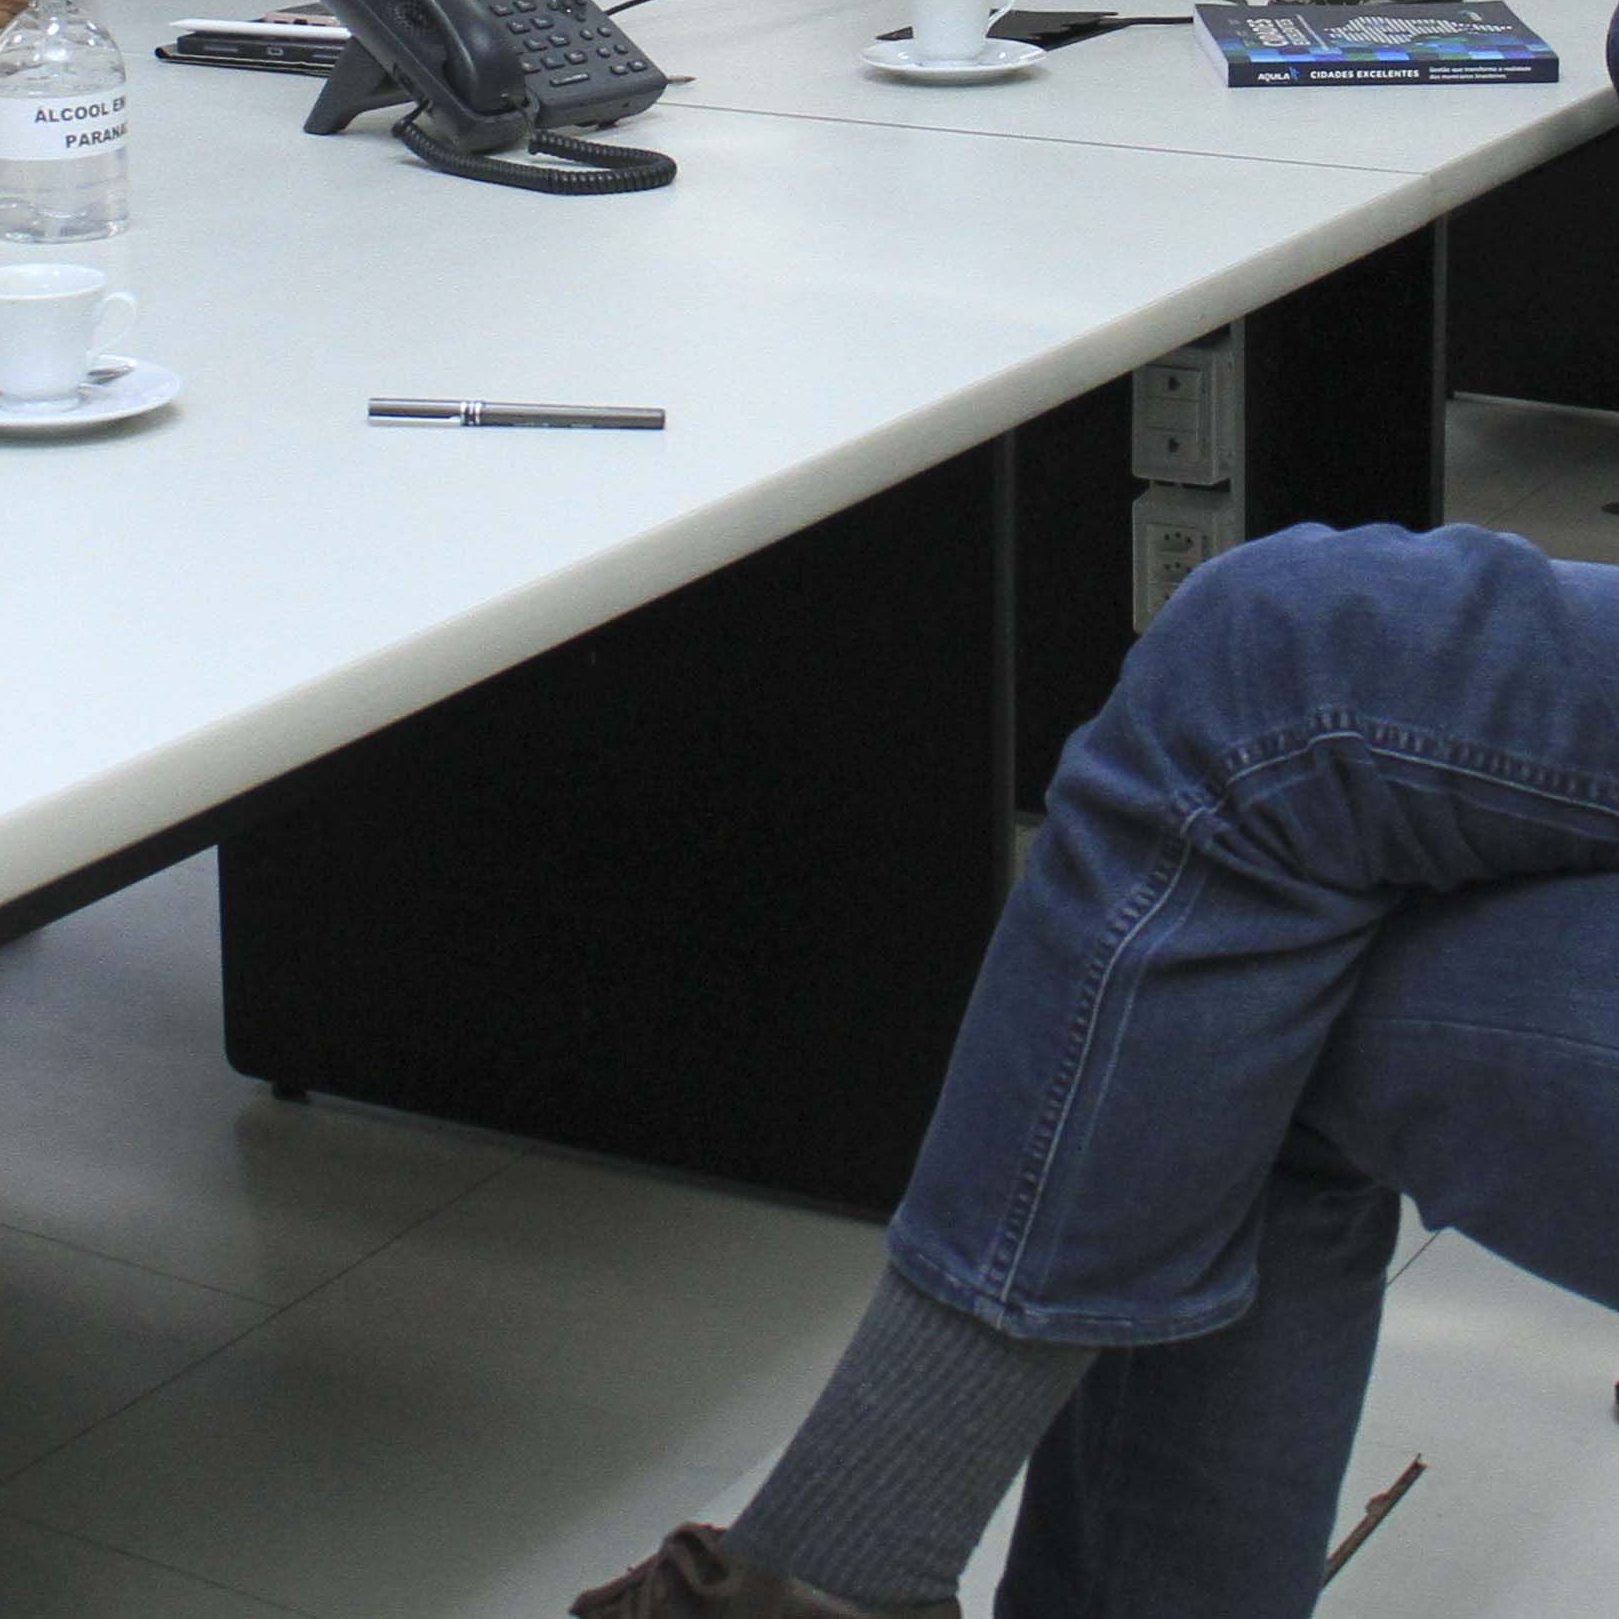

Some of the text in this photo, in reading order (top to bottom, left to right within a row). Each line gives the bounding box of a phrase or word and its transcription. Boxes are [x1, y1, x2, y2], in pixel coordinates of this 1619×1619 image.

[1257, 72, 1290, 83] AQUILA
[1309, 70, 1354, 79] CIDADES
[1356, 69, 1420, 79] EXCELENTES
